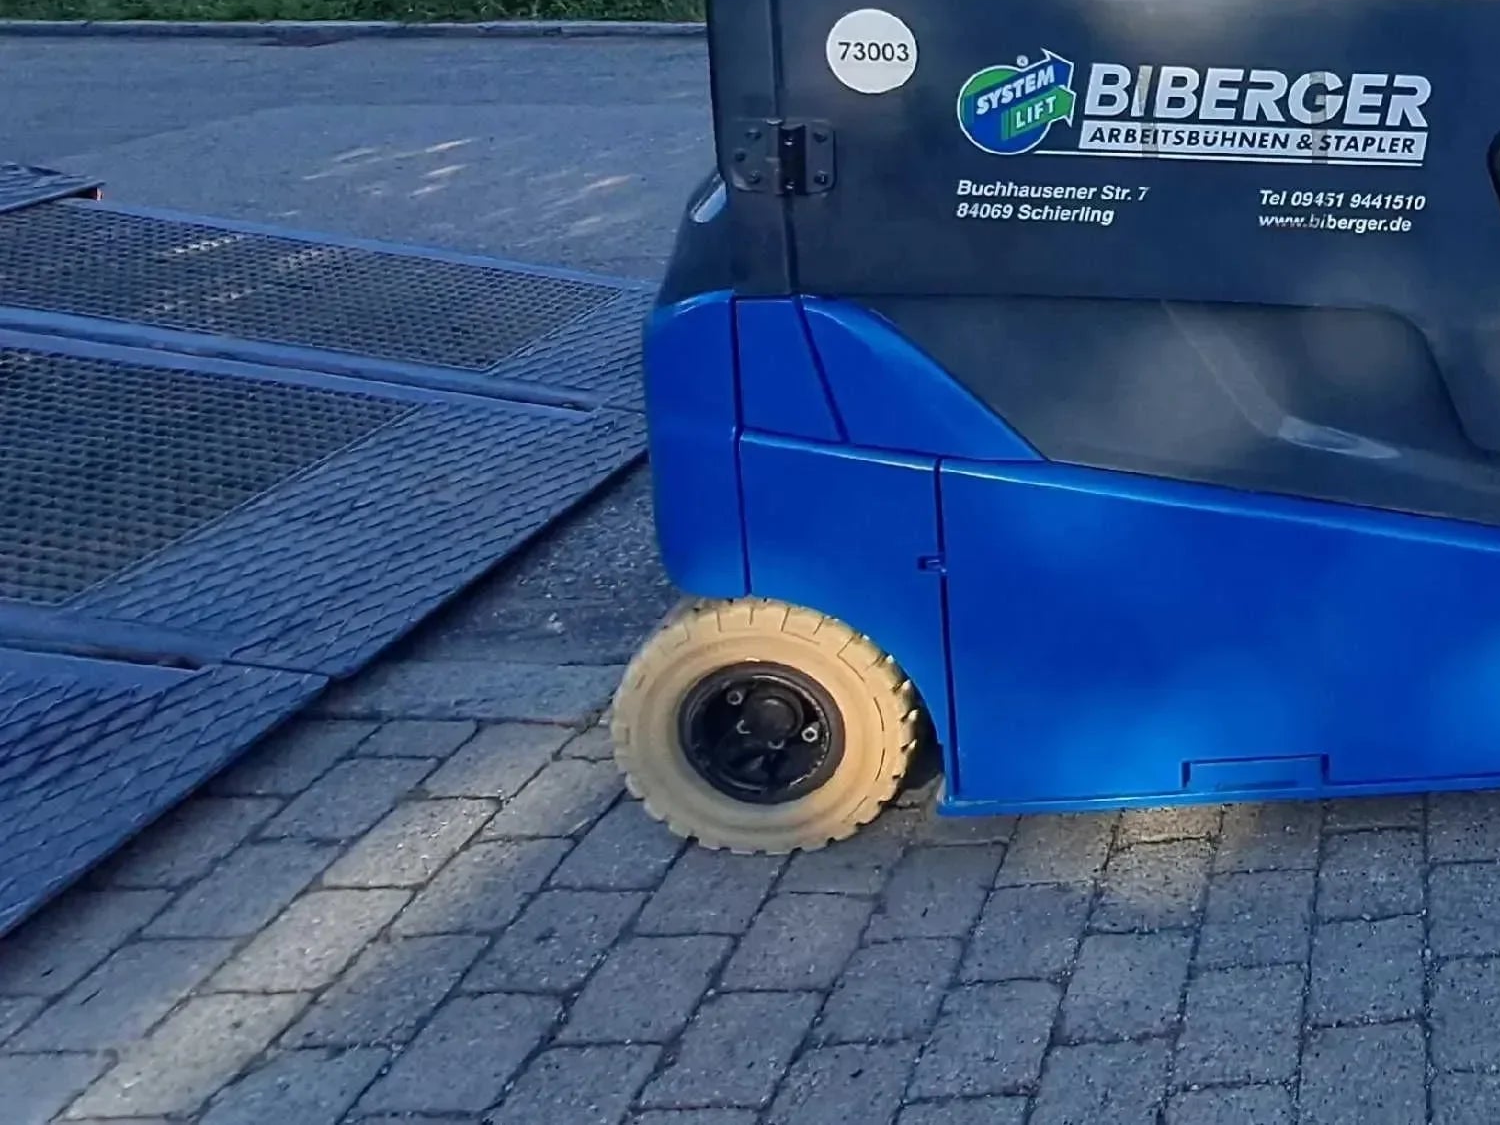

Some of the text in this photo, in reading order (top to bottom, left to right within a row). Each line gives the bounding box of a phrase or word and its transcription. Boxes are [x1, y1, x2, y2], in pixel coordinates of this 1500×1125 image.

[838, 41, 909, 62] 73003
[975, 65, 1055, 115] SYSTEM
[1084, 63, 1432, 127] BIBERGER
[1016, 95, 1057, 128] LIFT
[1088, 126, 1416, 154] ARBEITSBÜHNEN & STAPLER
[956, 179, 1151, 201] Buchhausener Str. 7
[1259, 189, 1426, 211] Tel 09451 9441510
[956, 203, 1115, 226] 84069 Schierling
[1258, 213, 1412, 234] www.biberger.de
